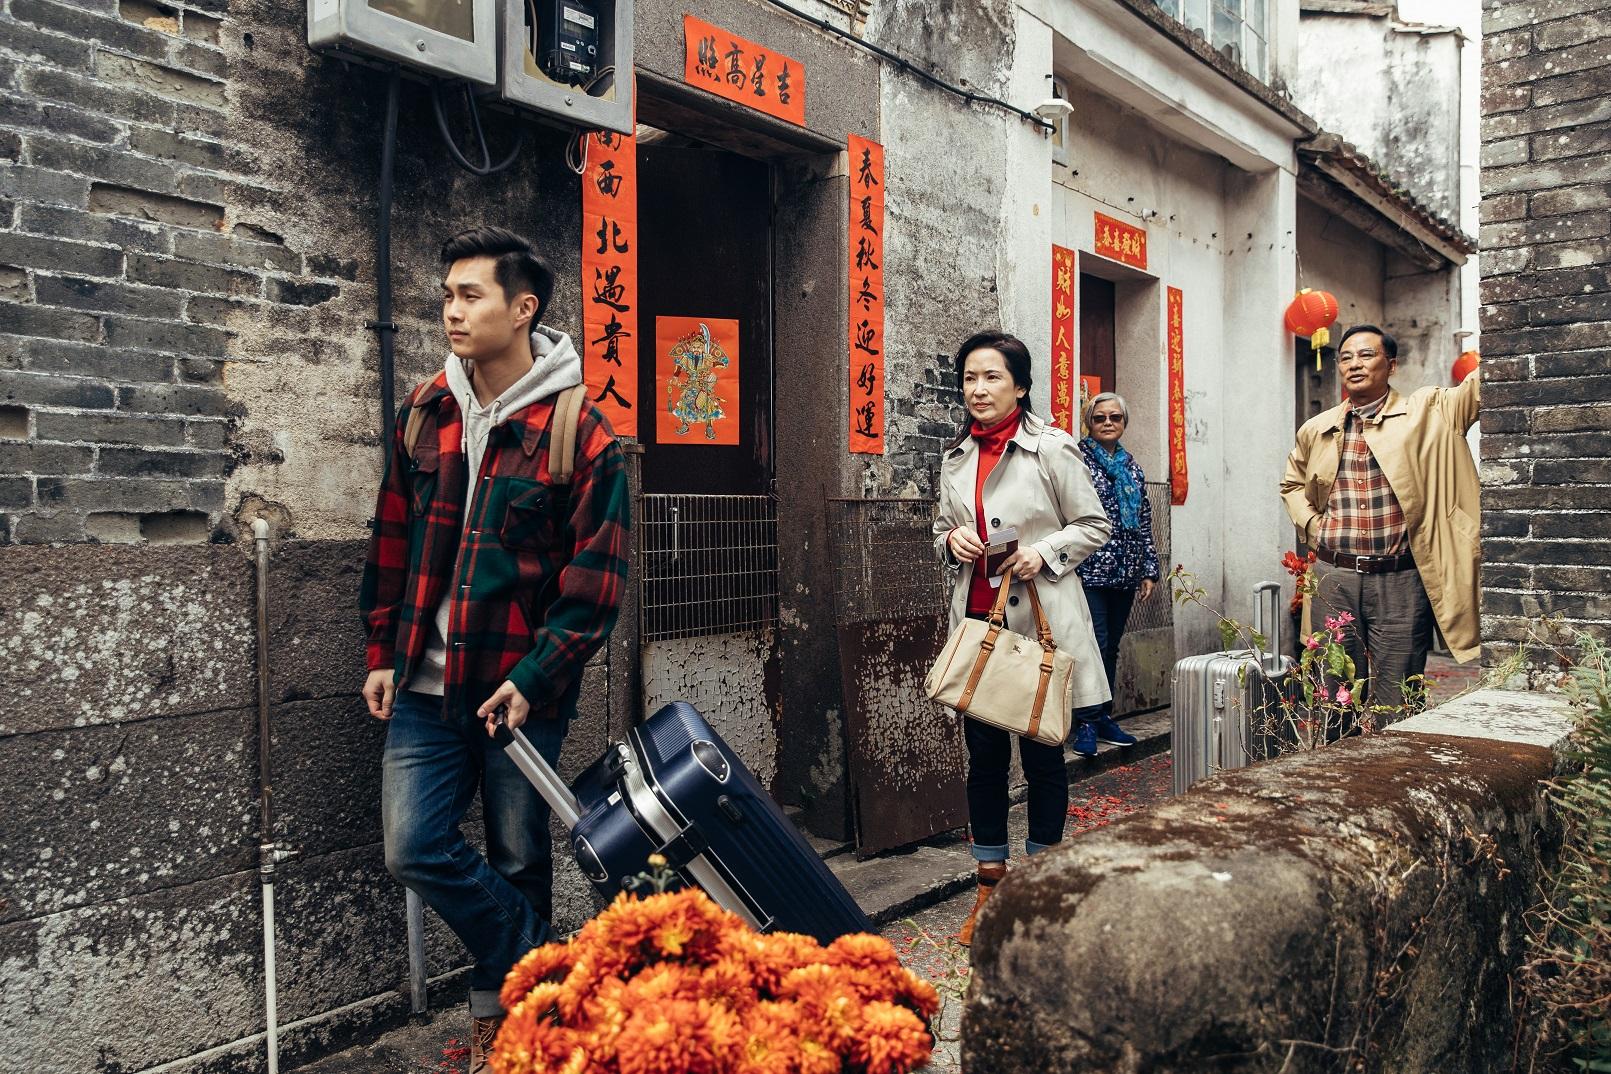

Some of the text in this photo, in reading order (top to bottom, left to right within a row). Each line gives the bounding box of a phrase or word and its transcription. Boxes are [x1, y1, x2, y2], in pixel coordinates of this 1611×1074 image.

[855, 146, 879, 439] 春夏秋冬迎好運
